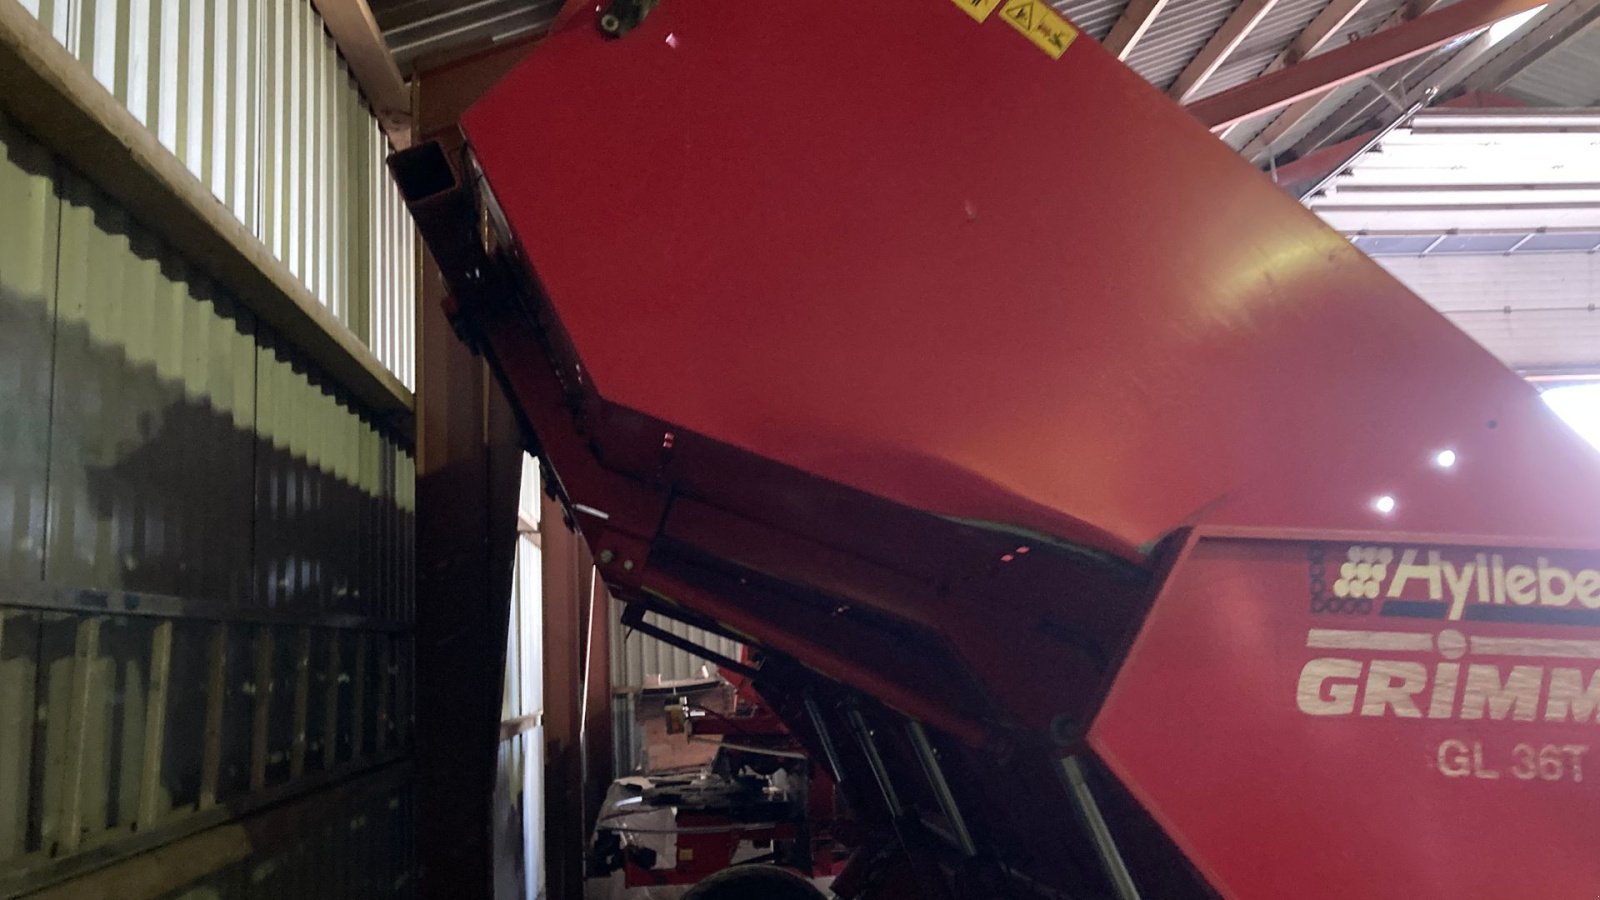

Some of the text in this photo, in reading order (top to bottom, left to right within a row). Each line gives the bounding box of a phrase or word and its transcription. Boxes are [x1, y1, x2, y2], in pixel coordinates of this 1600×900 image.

[1386, 549, 1600, 621] Hyllebe
[1437, 739, 1589, 783] GL 36T
